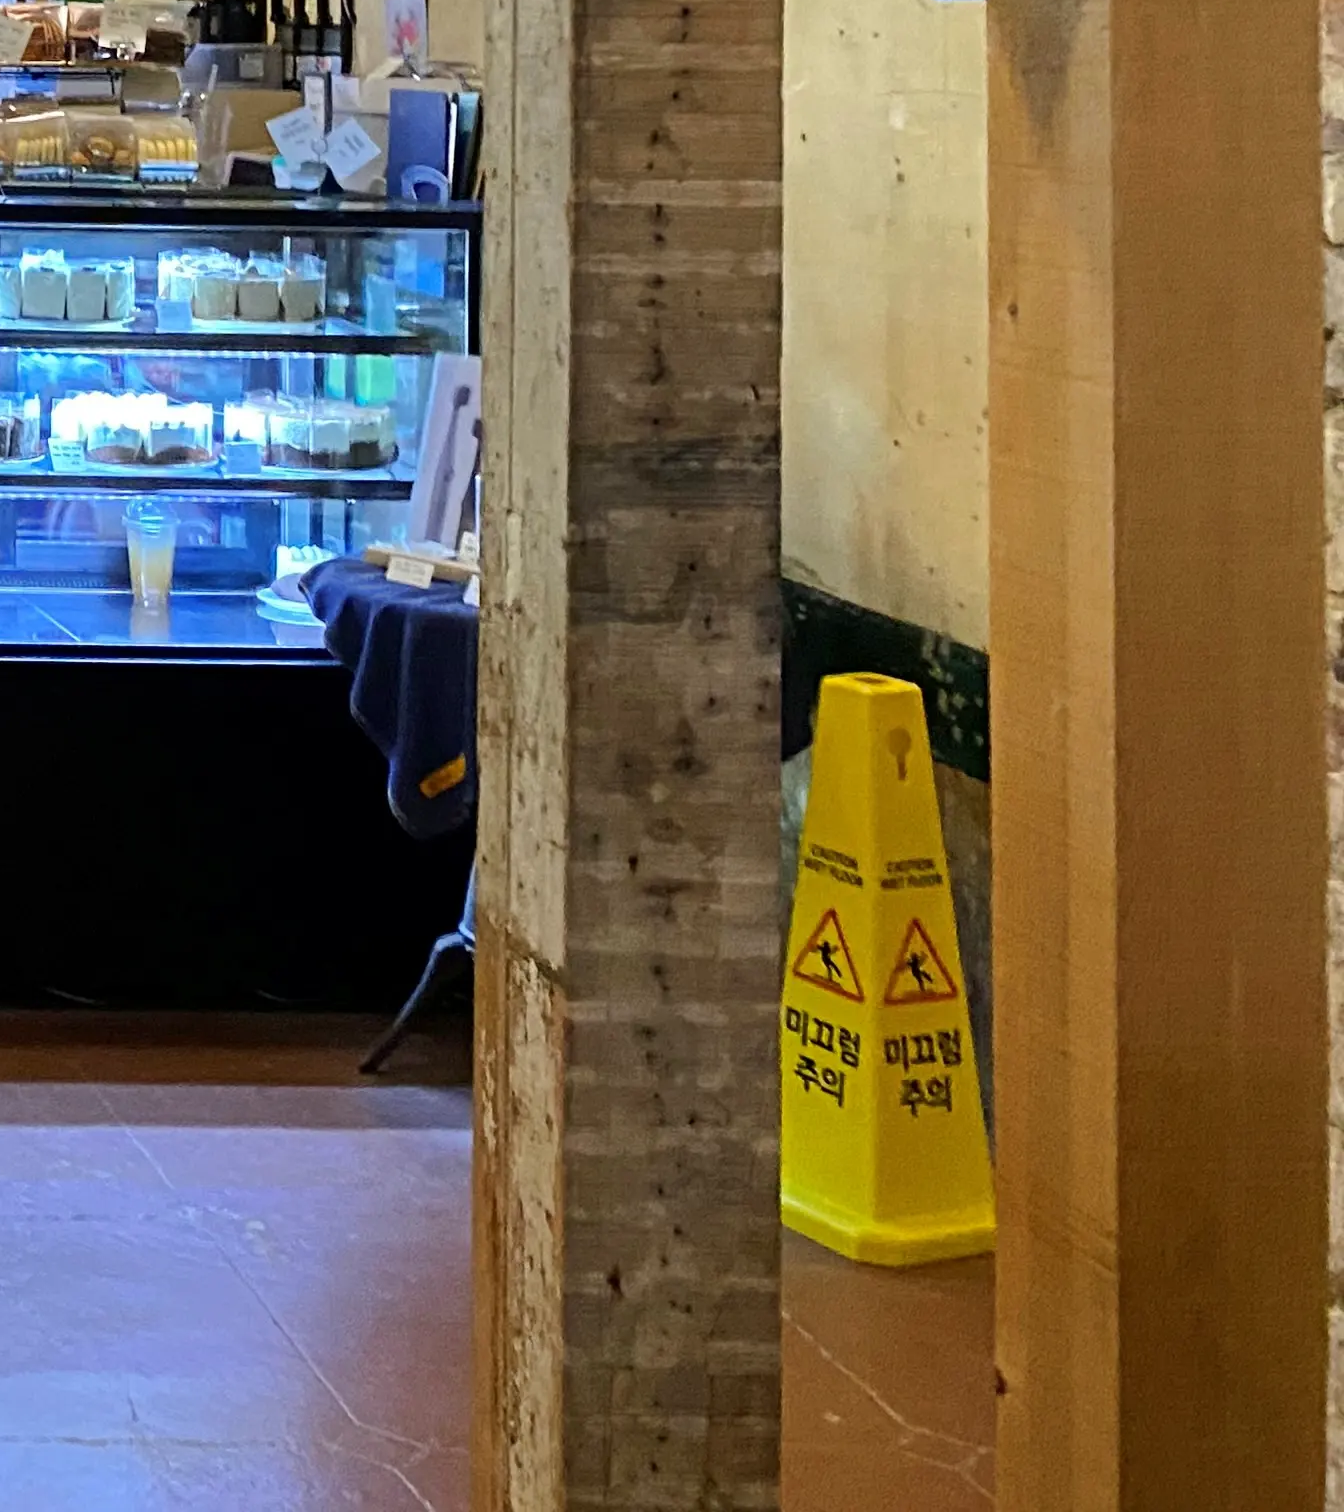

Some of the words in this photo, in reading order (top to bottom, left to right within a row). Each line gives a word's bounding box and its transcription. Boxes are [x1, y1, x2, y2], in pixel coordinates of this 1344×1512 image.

[785, 1005, 861, 1071] 미끄럼
[883, 1028, 962, 1073] 미끄럼
[794, 1054, 845, 1109] 주의
[900, 1075, 953, 1118] 주의
